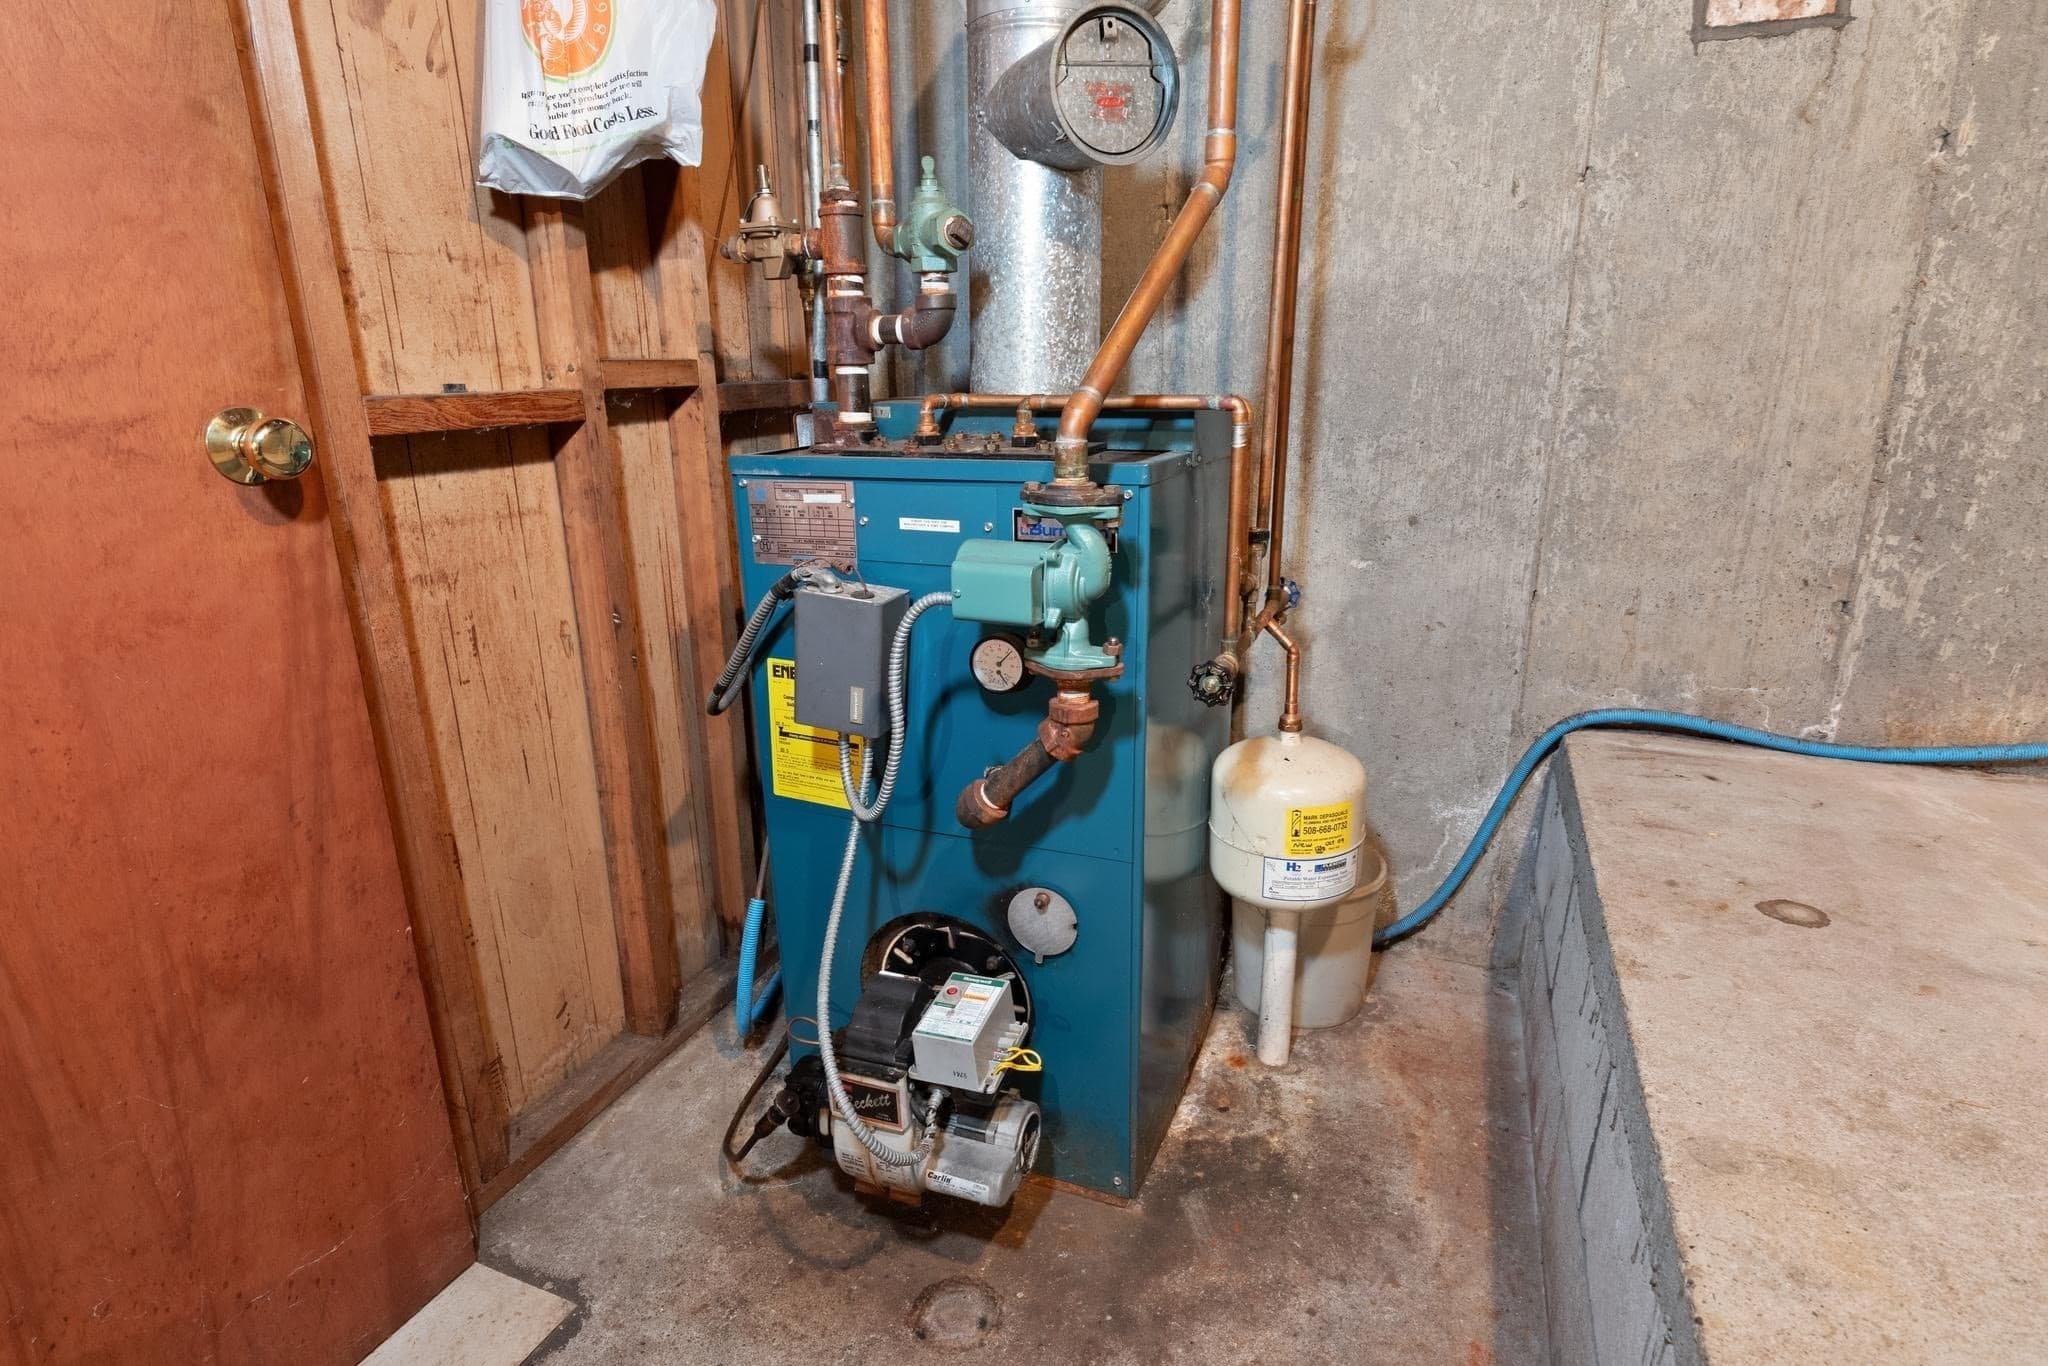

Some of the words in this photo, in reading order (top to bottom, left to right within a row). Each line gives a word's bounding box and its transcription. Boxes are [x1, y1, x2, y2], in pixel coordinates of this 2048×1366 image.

[609, 69, 649, 84] satisfaction
[610, 86, 619, 95] or
[529, 122, 560, 141] Good
[562, 119, 593, 140] Food
[593, 110, 625, 133] Costs
[625, 105, 658, 121] Less.
[848, 1093, 892, 1109] eckett
[927, 1171, 952, 1184] Carlin
